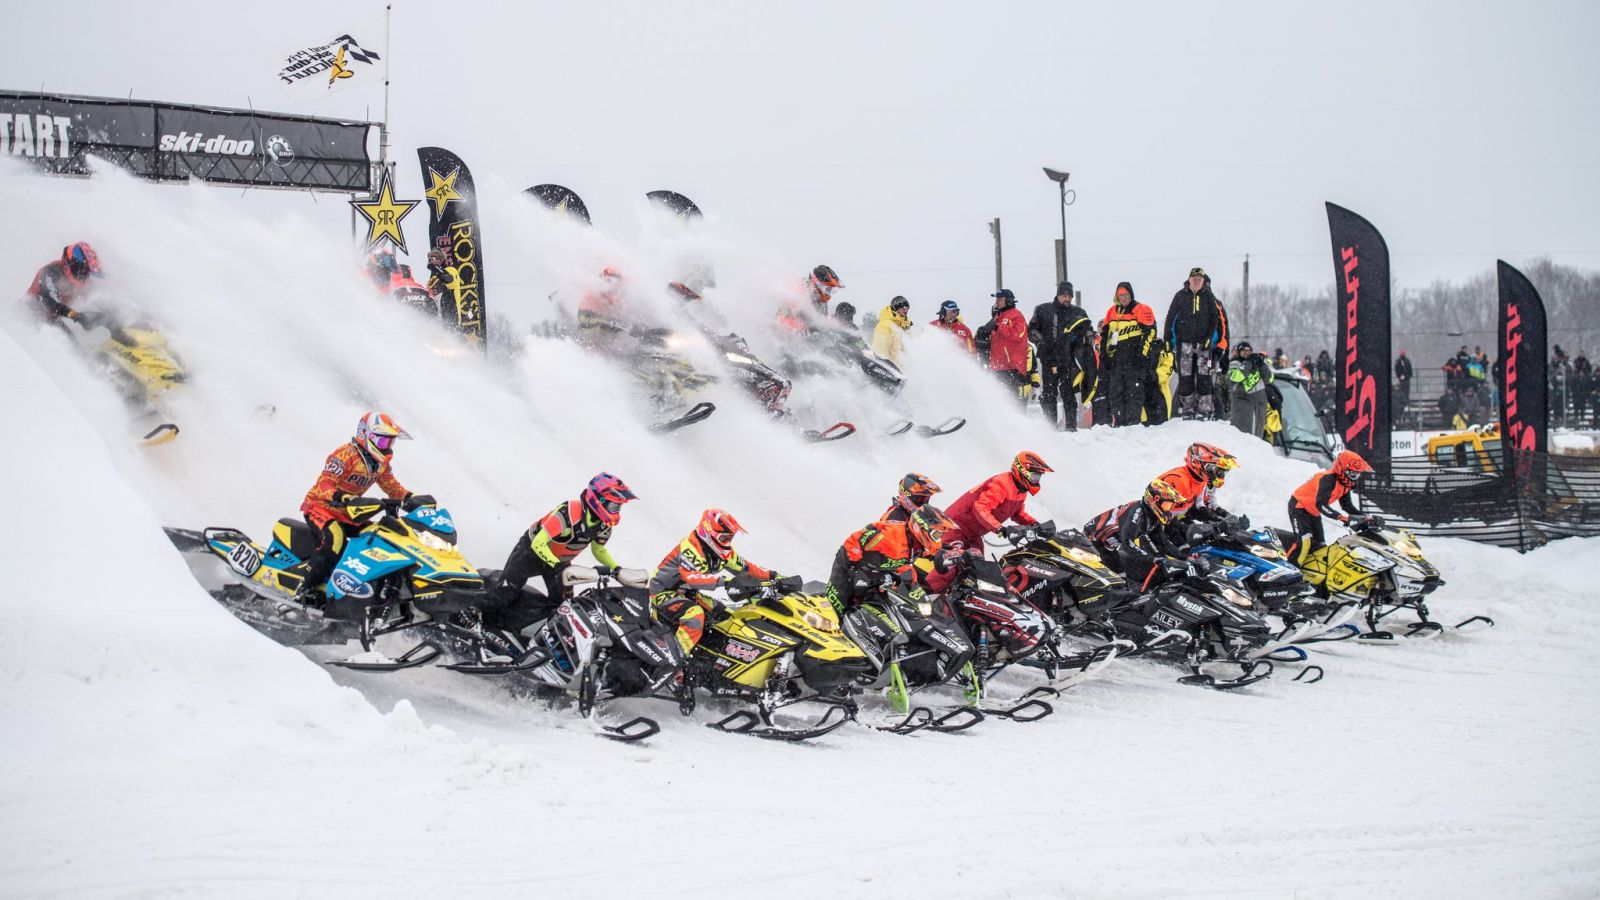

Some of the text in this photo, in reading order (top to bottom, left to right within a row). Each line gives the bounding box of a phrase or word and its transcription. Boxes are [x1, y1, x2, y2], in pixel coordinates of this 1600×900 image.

[0, 113, 71, 158] TART
[159, 132, 255, 156] ski-doo
[451, 220, 482, 331] ROCKST
[231, 543, 258, 572] 820
[342, 556, 372, 576] XPS
[336, 574, 362, 594] Ford
[1176, 595, 1204, 615] Mystik
[637, 641, 655, 657] ARCTIC
[651, 652, 664, 662] CAT
